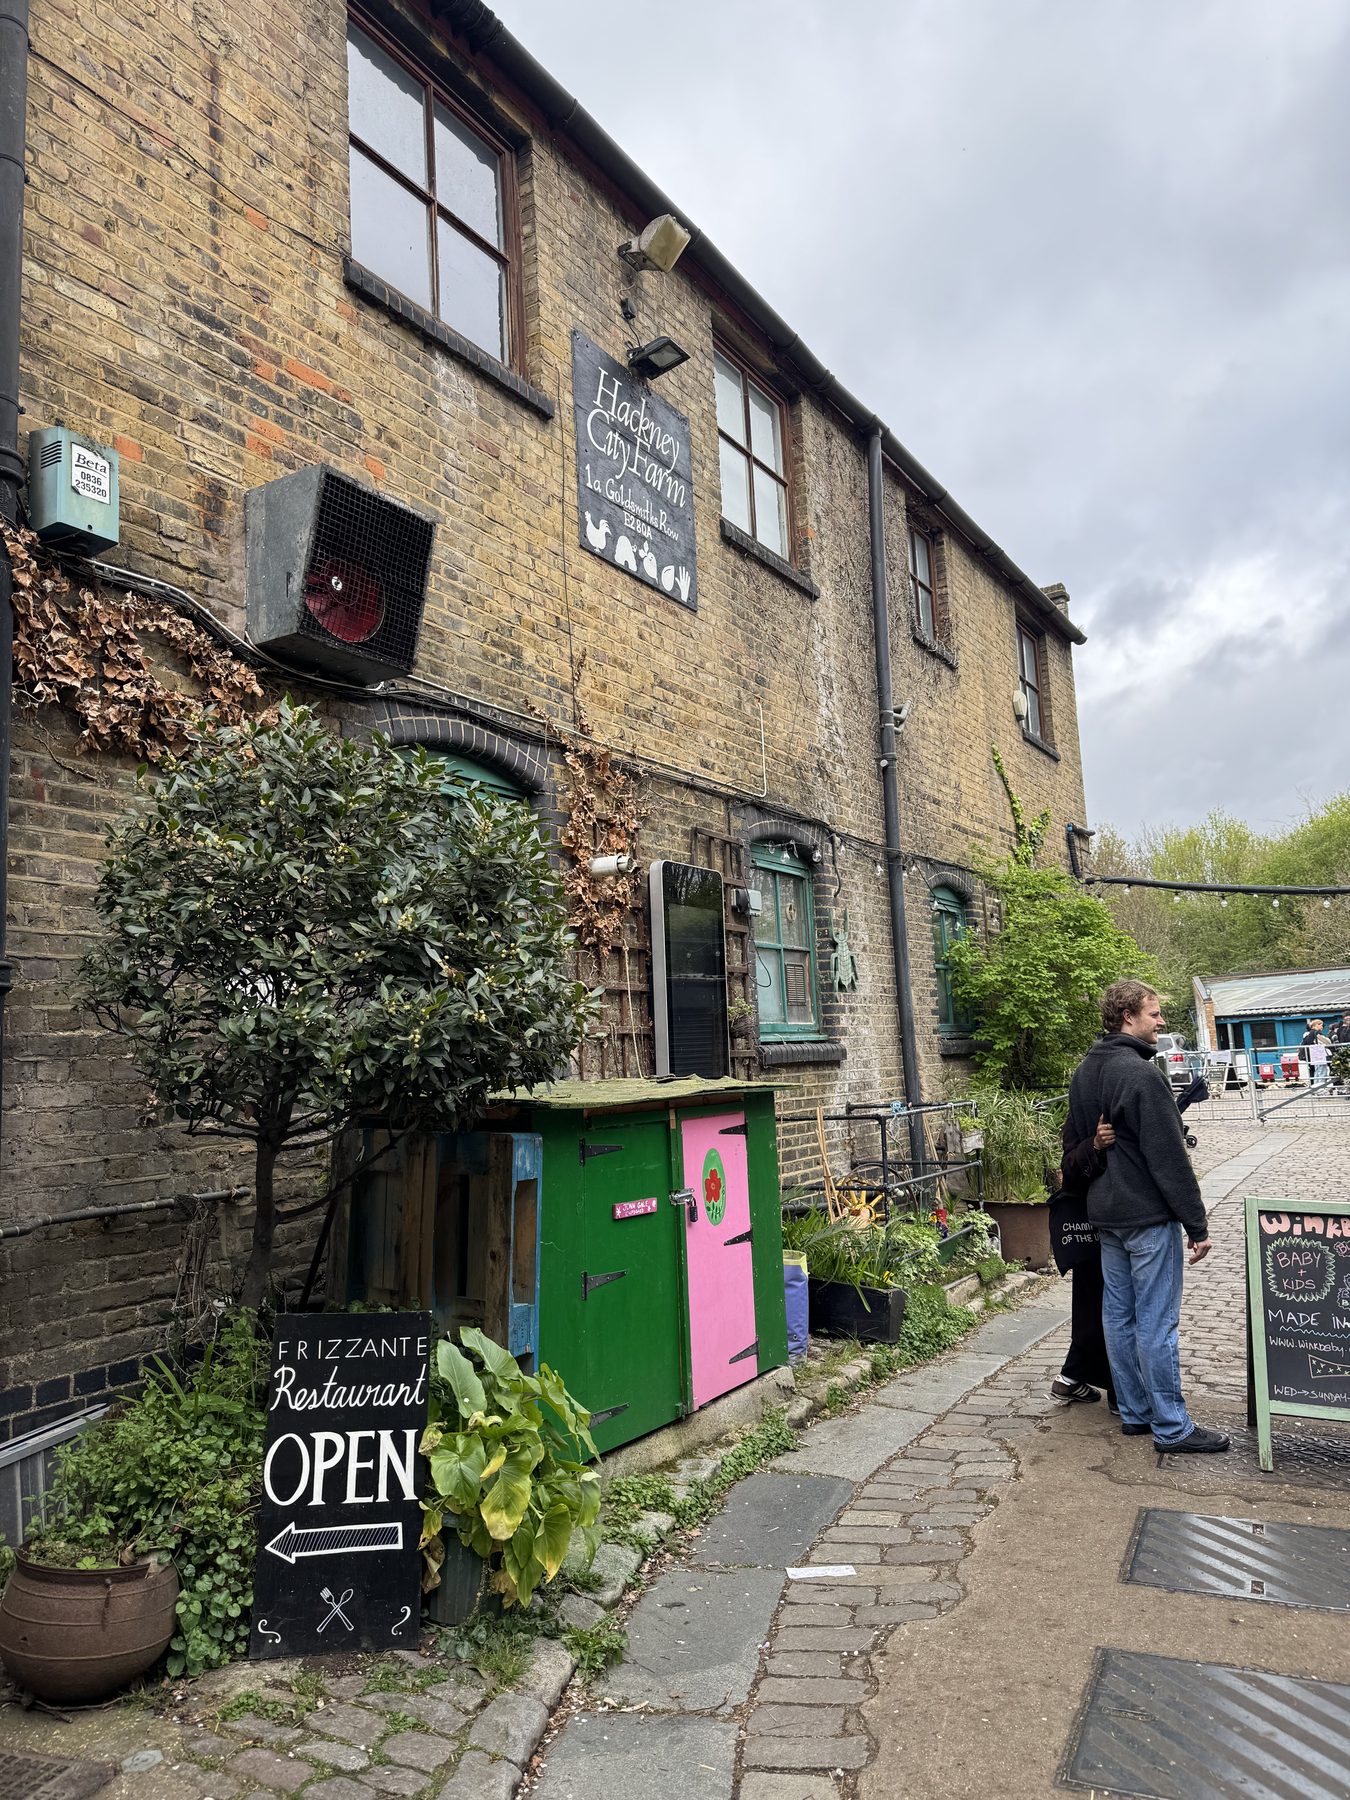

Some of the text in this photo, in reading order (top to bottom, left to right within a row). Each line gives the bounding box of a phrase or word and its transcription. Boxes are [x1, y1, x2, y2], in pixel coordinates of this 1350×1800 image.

[593, 366, 680, 473] Hackney
[76, 453, 107, 474] Beta
[587, 408, 686, 508] City Farm
[75, 479, 107, 498] 235320
[80, 471, 102, 486] 0836
[605, 478, 659, 528] Goldsmiths
[659, 509, 679, 541] Row
[1062, 1223, 1093, 1231] CHAM
[1061, 1234, 1072, 1245] OF
[1074, 1234, 1093, 1242] THE
[1276, 1251, 1321, 1268] BABY
[1268, 1309, 1320, 1327] MADE
[278, 1336, 428, 1361] FRIZZANTE
[270, 1363, 427, 1411] Restaurant
[1274, 1384, 1298, 1397] WED
[263, 1428, 419, 1507] OPEN
